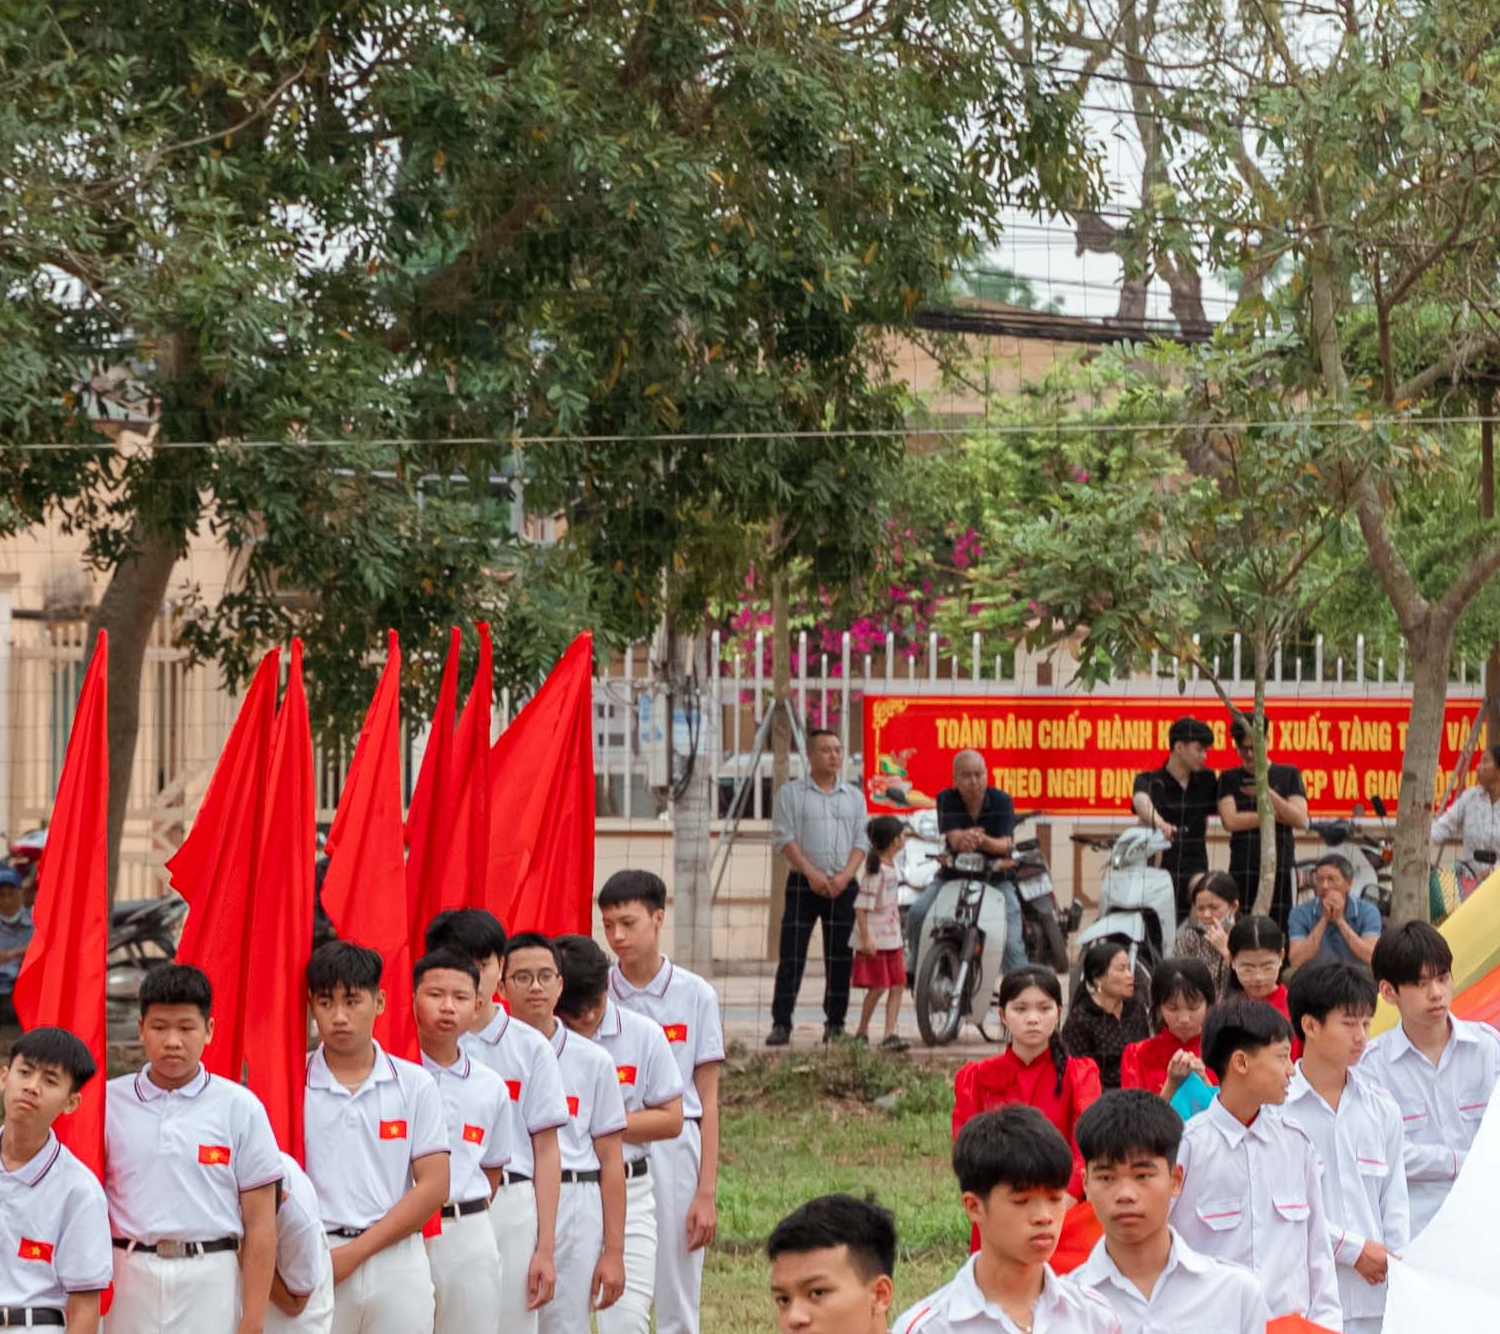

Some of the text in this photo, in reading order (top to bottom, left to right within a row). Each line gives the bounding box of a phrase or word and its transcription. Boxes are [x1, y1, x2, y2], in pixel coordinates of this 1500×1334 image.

[936, 711, 987, 749] TOÀN
[991, 713, 1033, 749] DÂN
[1038, 709, 1092, 750] CHẤP
[1097, 713, 1153, 750] HÀNH
[1279, 710, 1334, 754] XUẤT,
[1340, 715, 1392, 751] TÀNG
[992, 768, 1042, 798] THEO
[1047, 768, 1095, 805] NGHỊ
[1101, 768, 1138, 805] ĐỊN
[1332, 764, 1359, 799] VÀ
